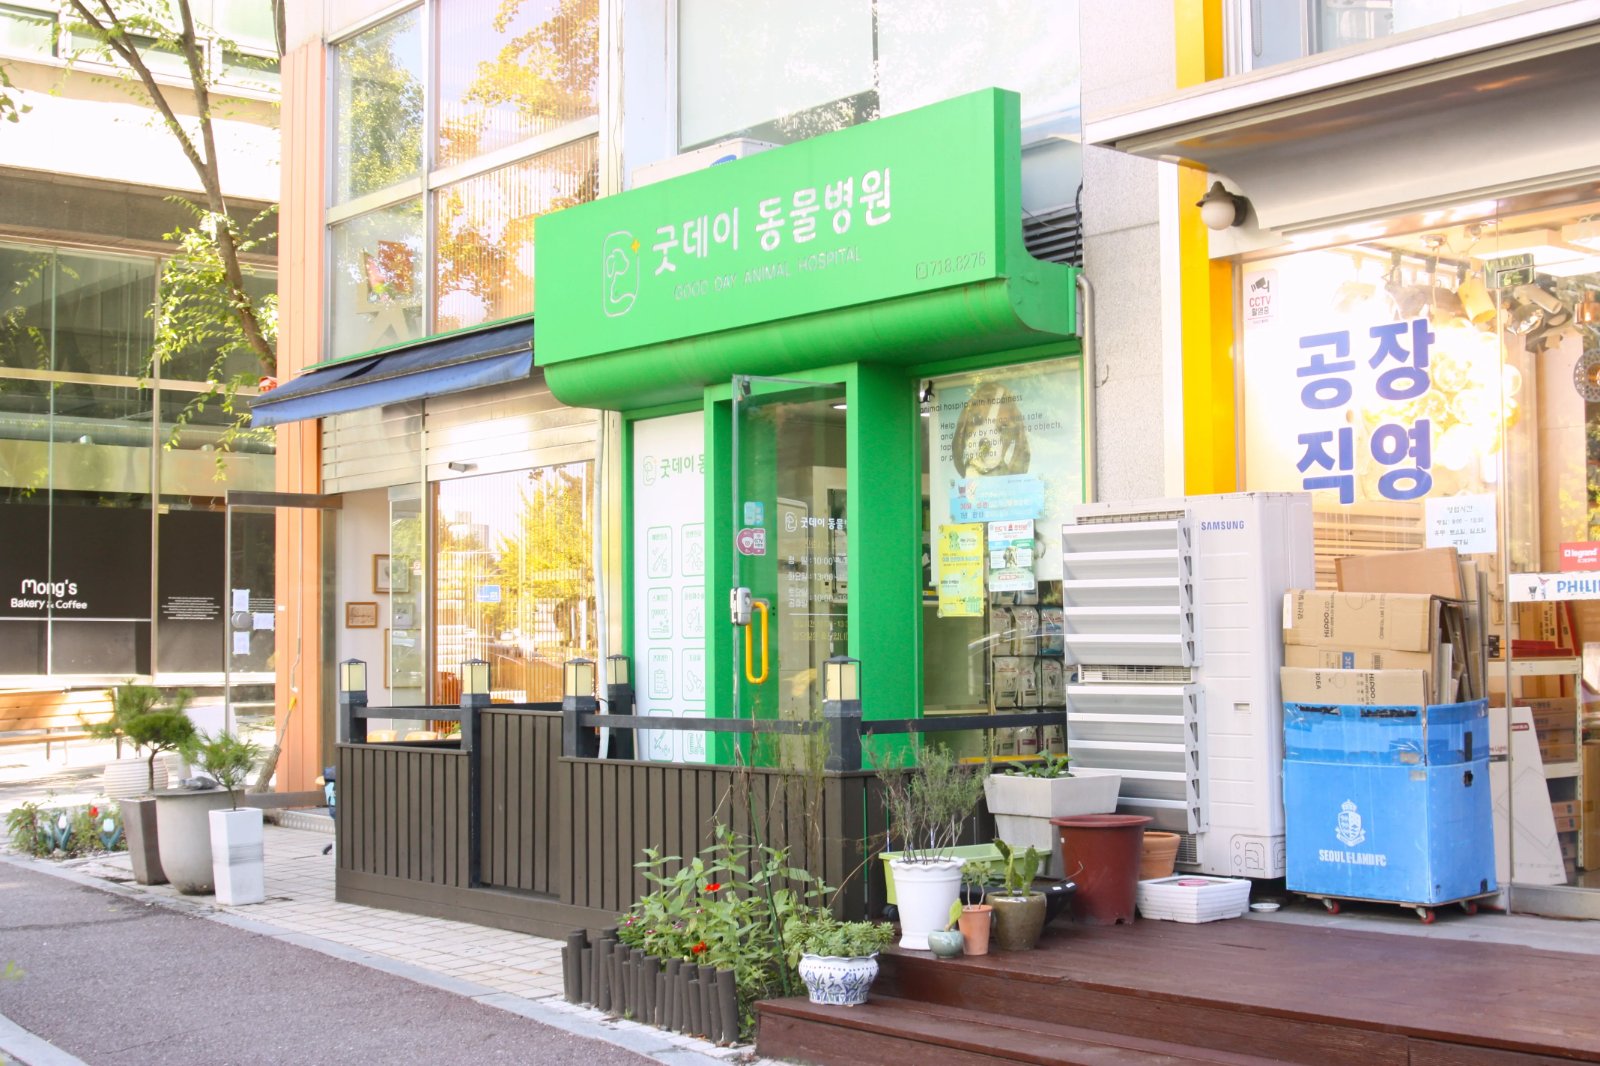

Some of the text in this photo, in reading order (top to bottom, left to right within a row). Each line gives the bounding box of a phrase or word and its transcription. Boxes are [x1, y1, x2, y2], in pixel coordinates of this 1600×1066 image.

[652, 167, 891, 276] 굿데이 동물병원
[673, 246, 862, 301] GOOD DAY ANIMAL HOSPITAL
[1249, 295, 1272, 307] CCTV
[1297, 318, 1436, 410] 공장
[660, 455, 694, 479] 굿데이
[1296, 419, 1433, 505] 직영
[800, 517, 847, 530] 굿데이 동물
[1201, 520, 1245, 531] SAMSUNG
[21, 578, 78, 598] Mong's
[10, 597, 46, 610] Bakery
[55, 600, 88, 610] Coffee
[1319, 849, 1345, 863] SEOUL
[1375, 854, 1387, 867] FC
